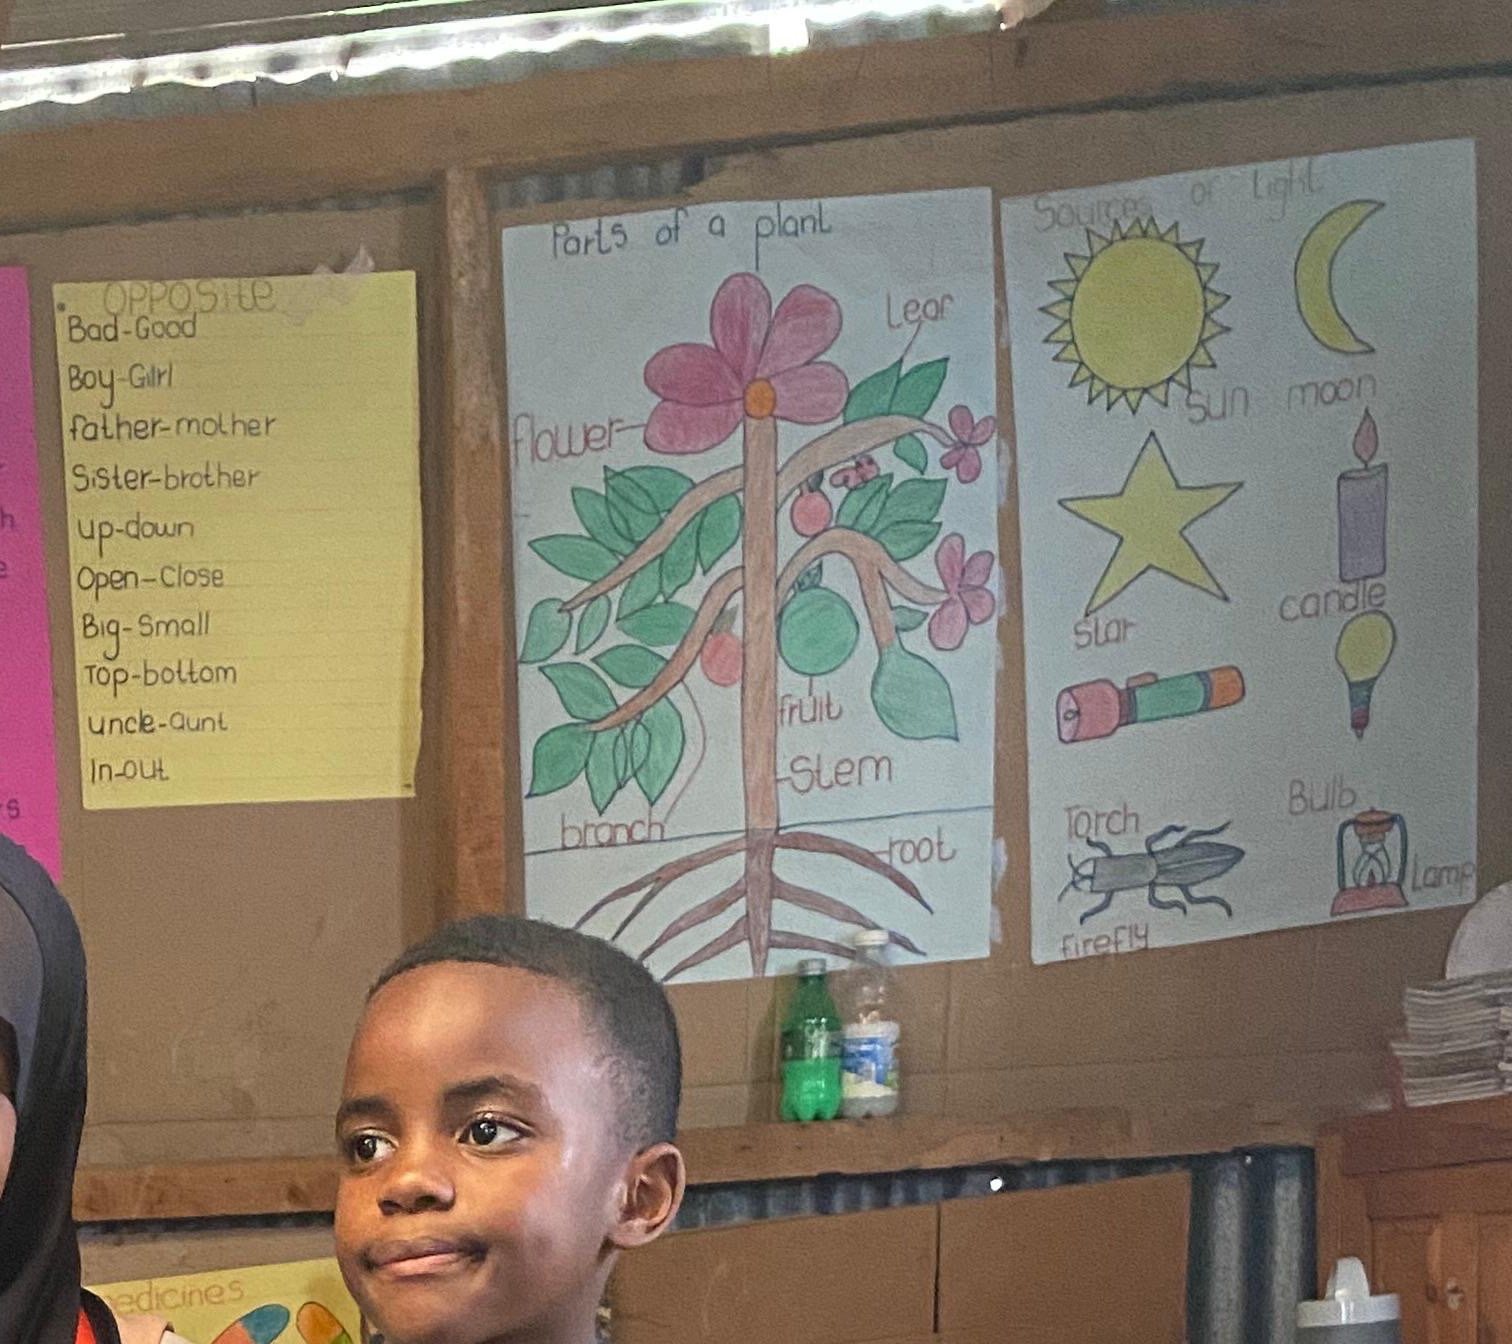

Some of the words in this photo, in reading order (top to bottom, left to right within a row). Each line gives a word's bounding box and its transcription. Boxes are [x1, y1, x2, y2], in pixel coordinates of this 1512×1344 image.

[552, 222, 628, 259] Parts
[656, 207, 687, 246] of
[708, 213, 725, 238] a
[753, 202, 834, 272] plant
[67, 311, 198, 343] Bad-Good
[1288, 774, 1357, 815] Bulb
